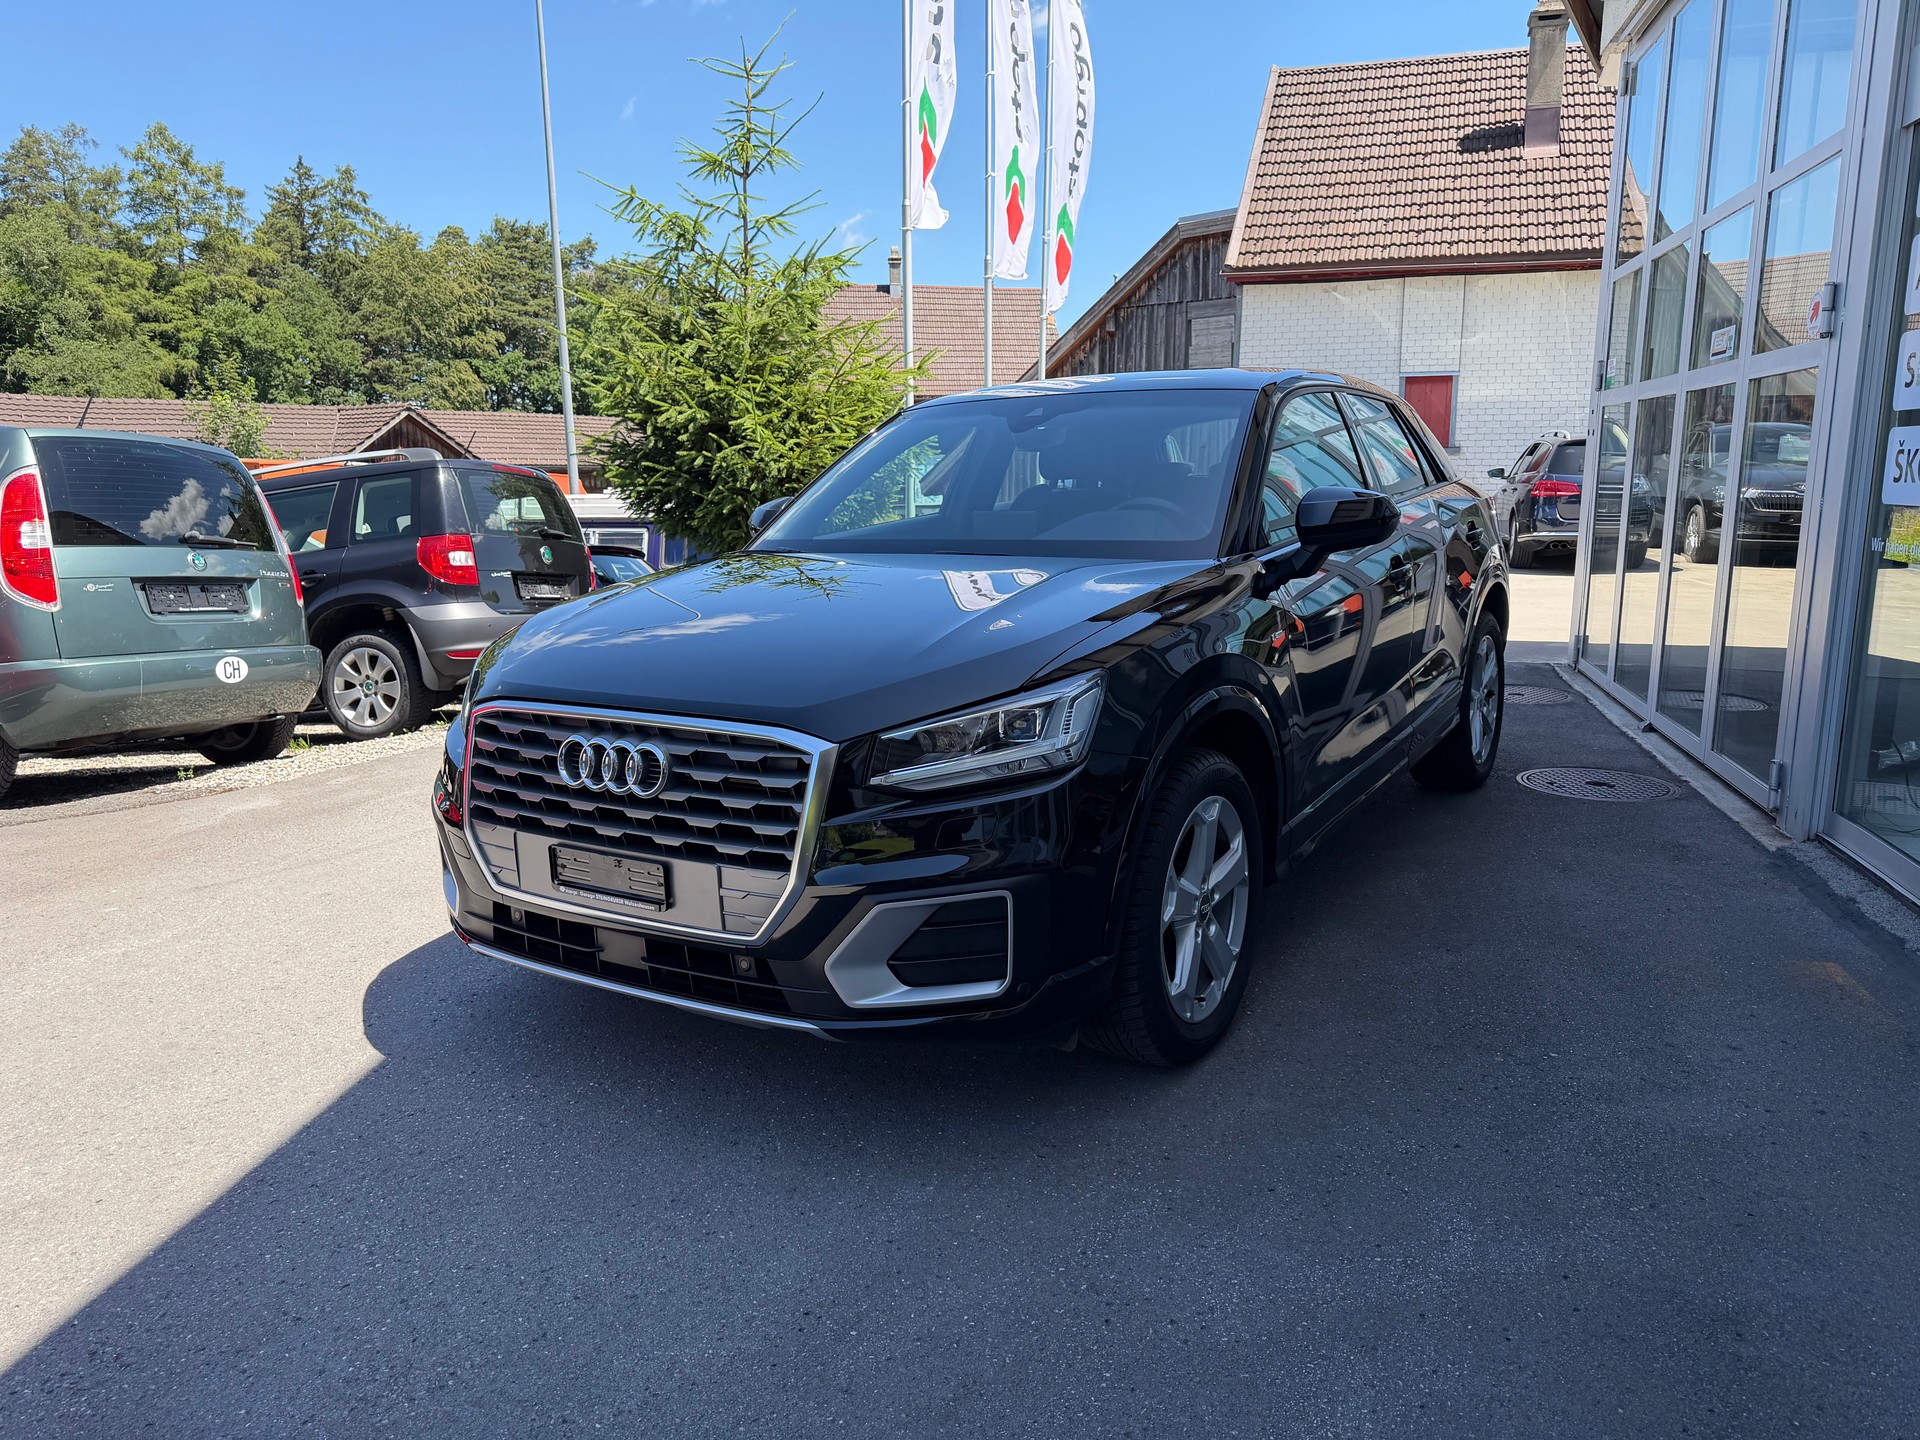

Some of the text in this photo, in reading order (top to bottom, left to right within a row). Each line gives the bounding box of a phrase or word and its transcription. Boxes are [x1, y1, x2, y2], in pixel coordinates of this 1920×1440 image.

[1893, 439, 1920, 484] ŠK
[1871, 537, 1885, 552] Wir
[1885, 538, 1908, 555] haben
[223, 660, 241, 680] CH
